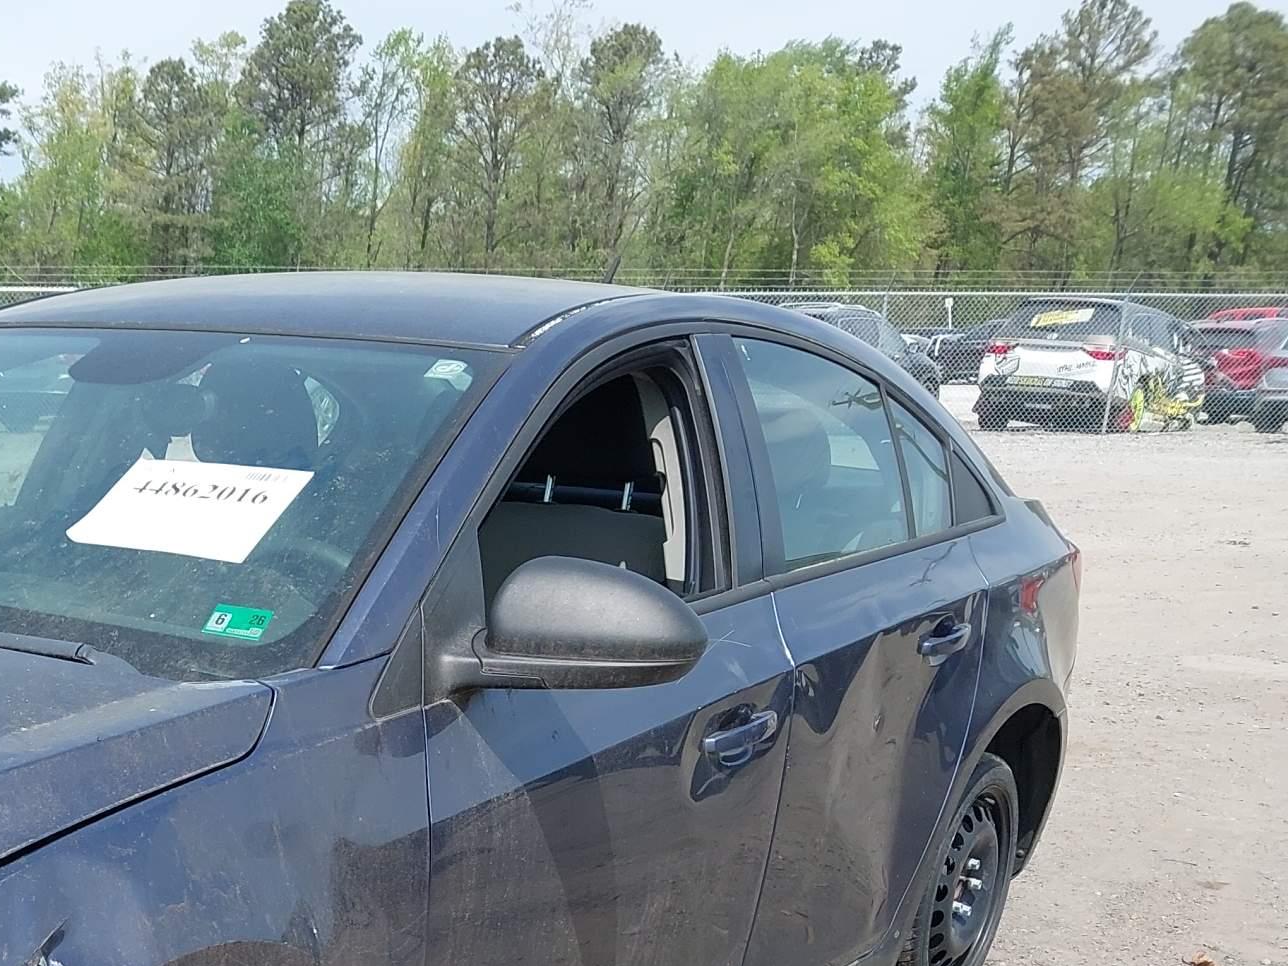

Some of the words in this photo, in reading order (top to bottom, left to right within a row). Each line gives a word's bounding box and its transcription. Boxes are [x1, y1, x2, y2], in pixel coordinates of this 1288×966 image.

[133, 480, 268, 504] 44862016
[215, 613, 228, 625] 6
[249, 614, 267, 626] 26
